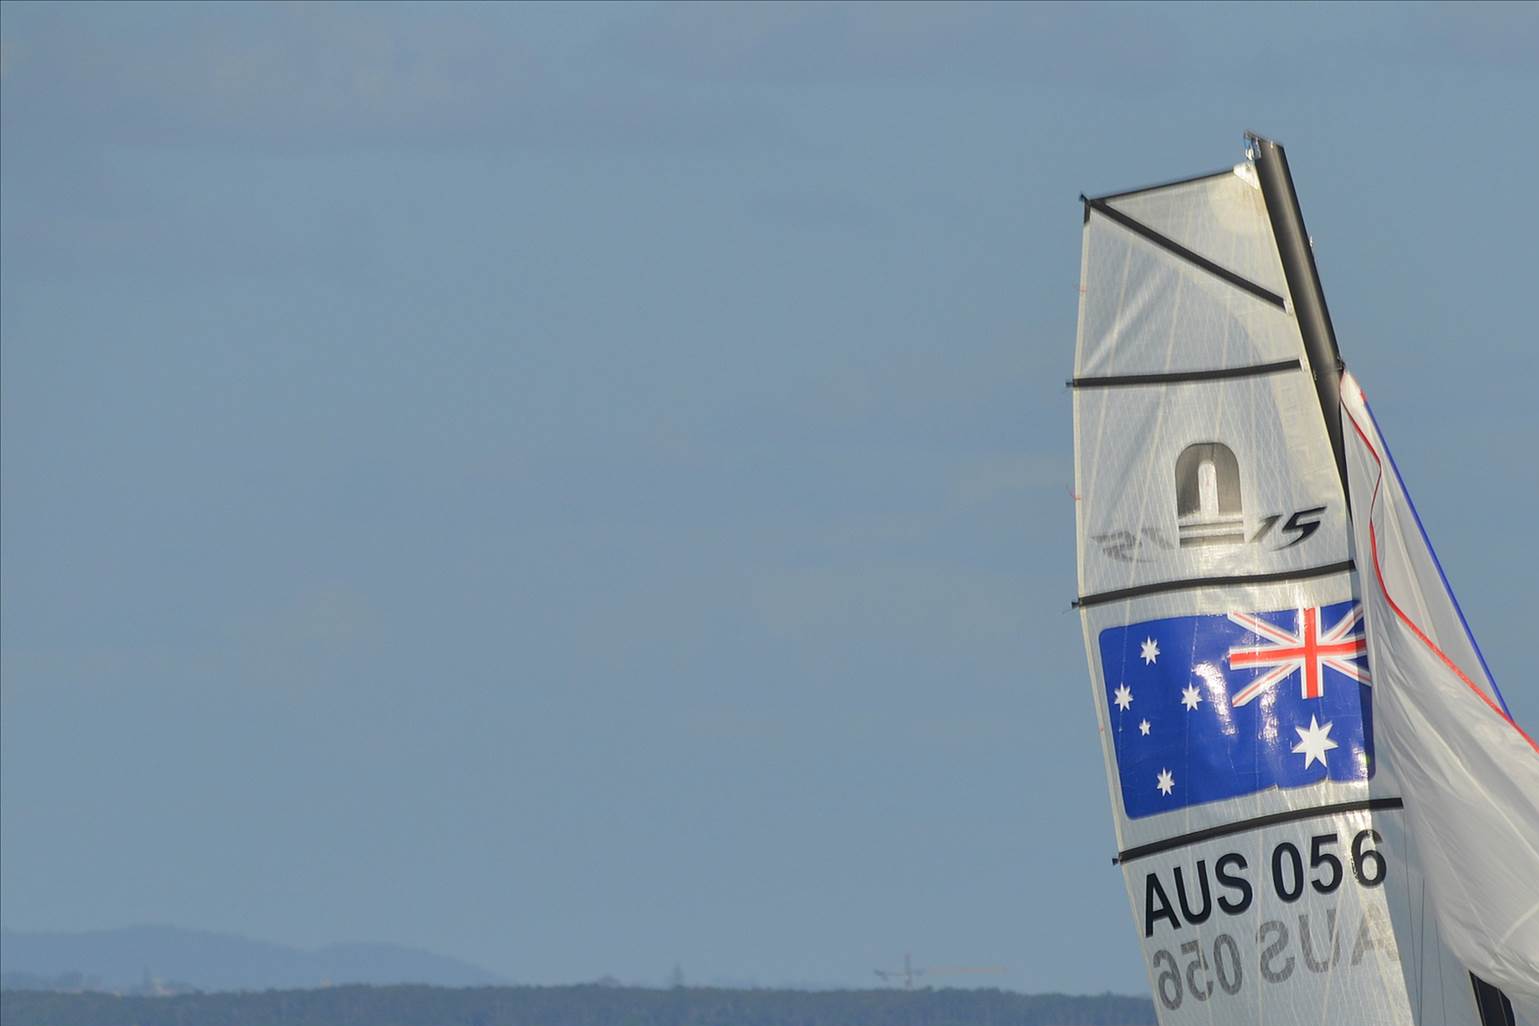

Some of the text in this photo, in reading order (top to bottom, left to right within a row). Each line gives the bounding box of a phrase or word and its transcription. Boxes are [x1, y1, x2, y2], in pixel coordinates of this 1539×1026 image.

[1248, 505, 1328, 552] 15
[1144, 829, 1387, 938] AUS 056
